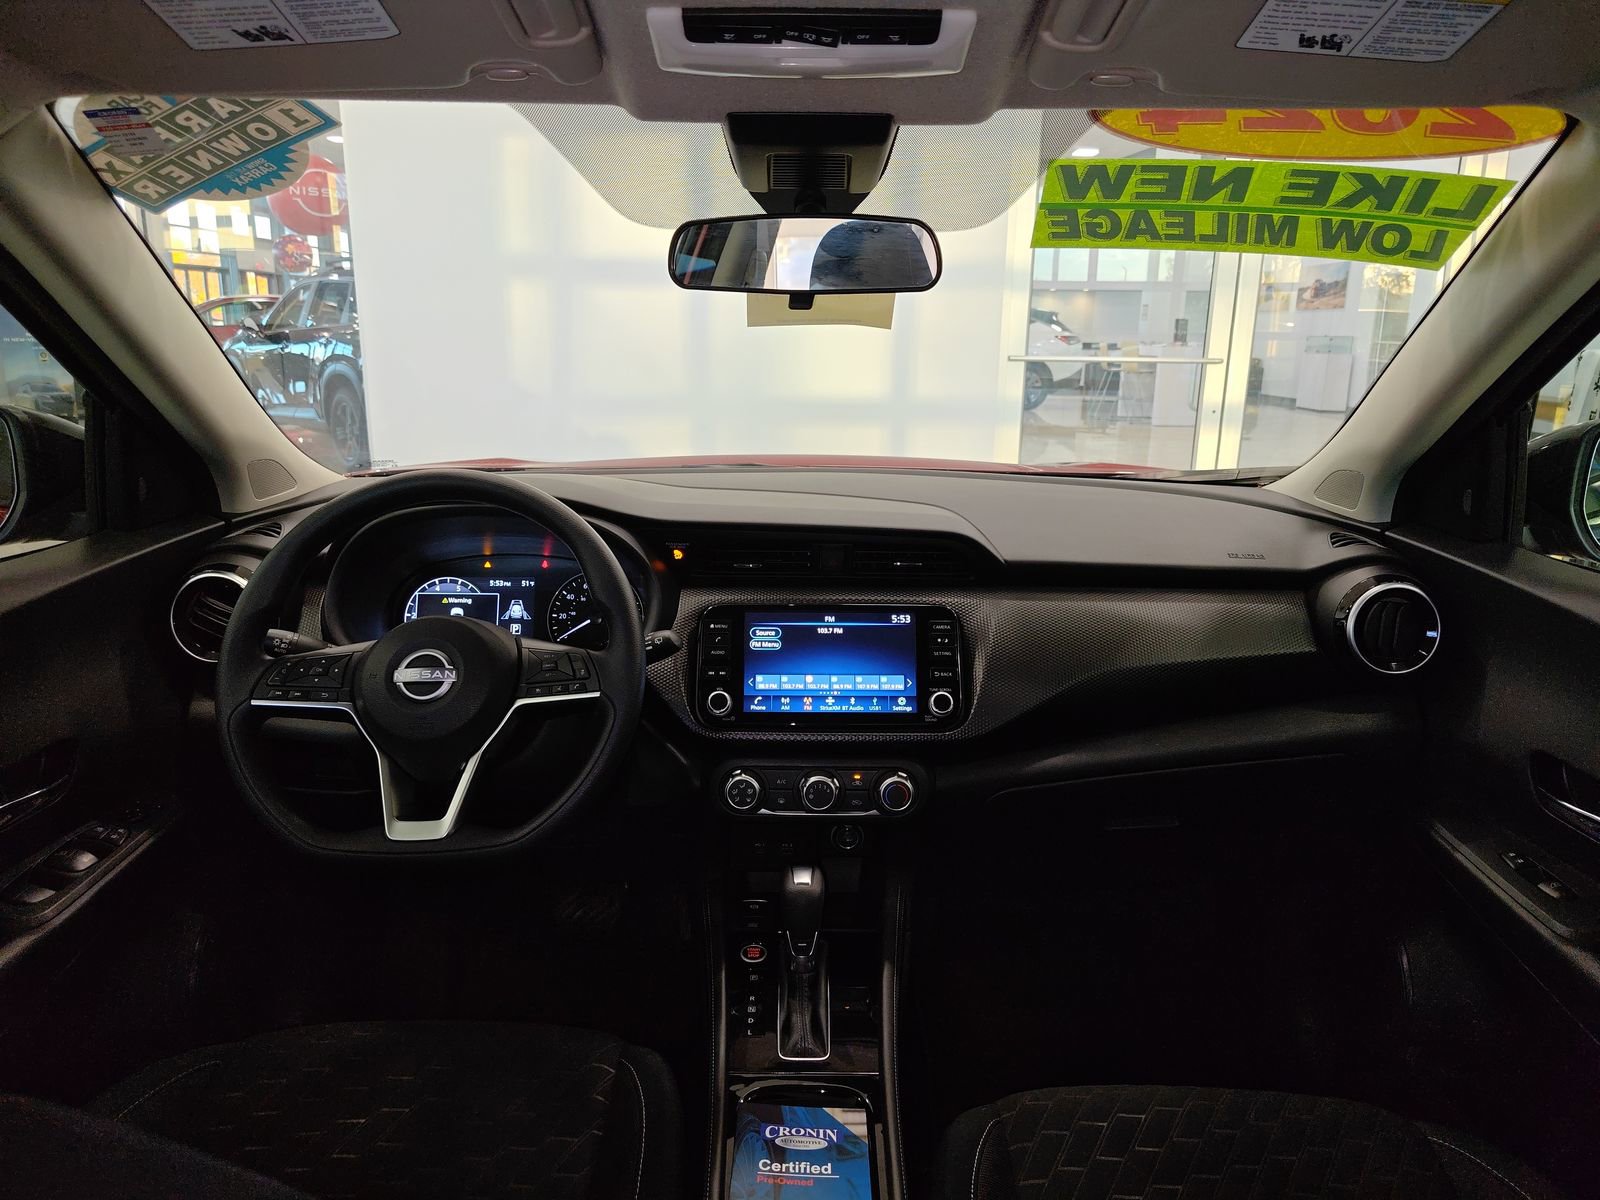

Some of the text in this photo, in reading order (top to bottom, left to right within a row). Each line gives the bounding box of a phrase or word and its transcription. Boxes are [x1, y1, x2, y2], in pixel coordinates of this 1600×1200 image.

[891, 615, 911, 624] 5:53
[755, 629, 776, 637] Source
[393, 670, 457, 680] NISSAN
[764, 1125, 838, 1143] CRONIN
[779, 1138, 822, 1146] AUTOMOTIVE
[758, 1159, 832, 1175] Certified
[756, 1175, 814, 1187] Pre-Owned
